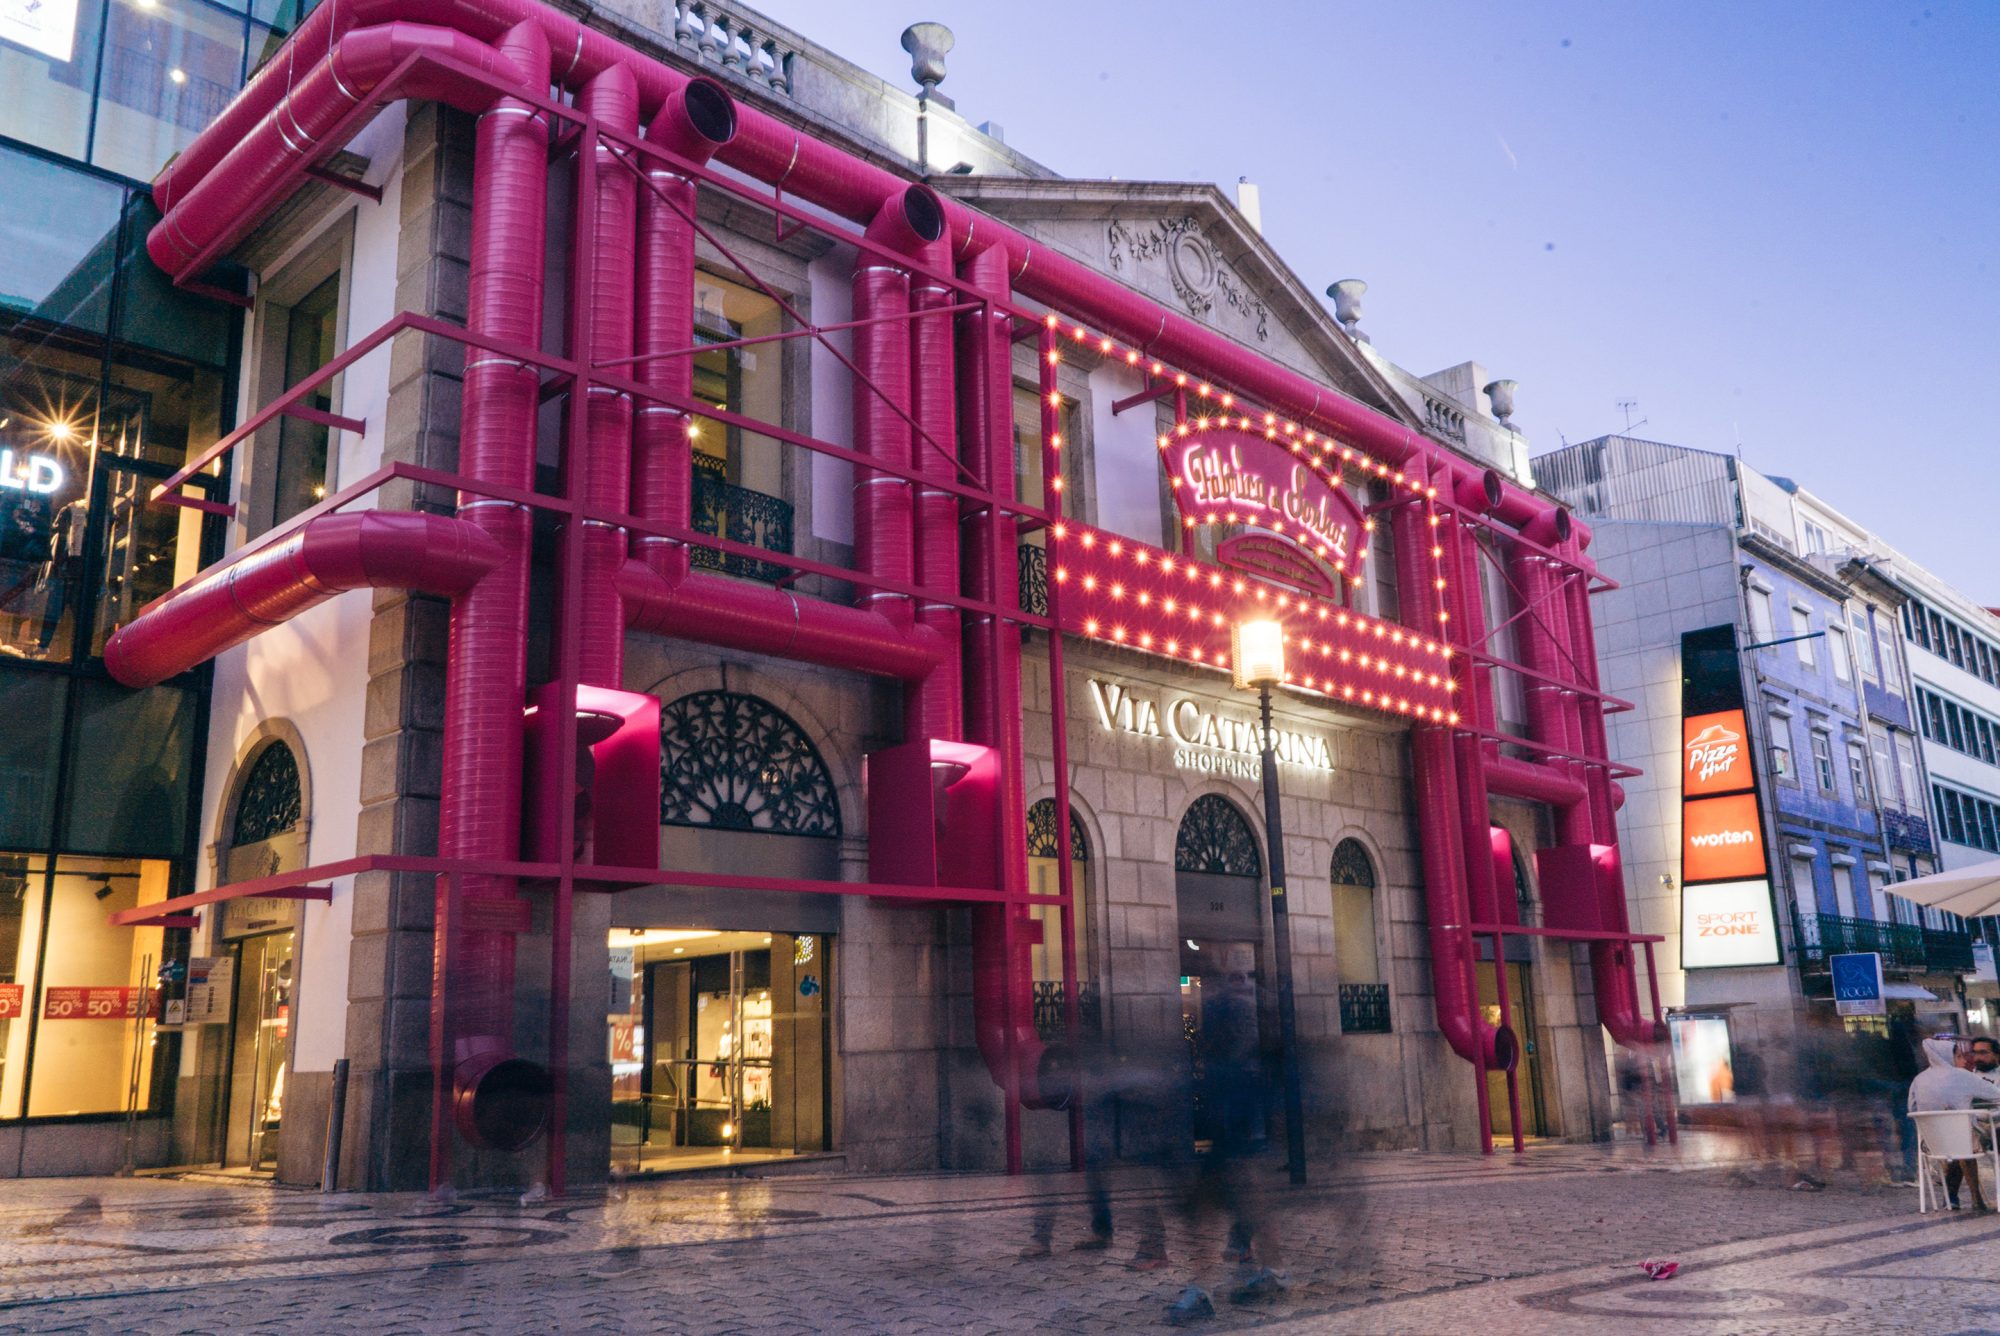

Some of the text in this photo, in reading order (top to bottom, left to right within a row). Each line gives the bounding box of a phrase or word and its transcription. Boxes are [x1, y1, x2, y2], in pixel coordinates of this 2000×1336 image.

[1174, 750, 1262, 780] SHOPPING
[1689, 744, 1738, 771] Pizza
[1699, 756, 1737, 782] Hut
[1690, 830, 1754, 847] worten
[1697, 911, 1758, 925] SPORT
[1697, 924, 1760, 937] ZONE
[1840, 985, 1874, 998] YOGA
[48, 999, 83, 1015] 50%
[87, 999, 121, 1015] 50%
